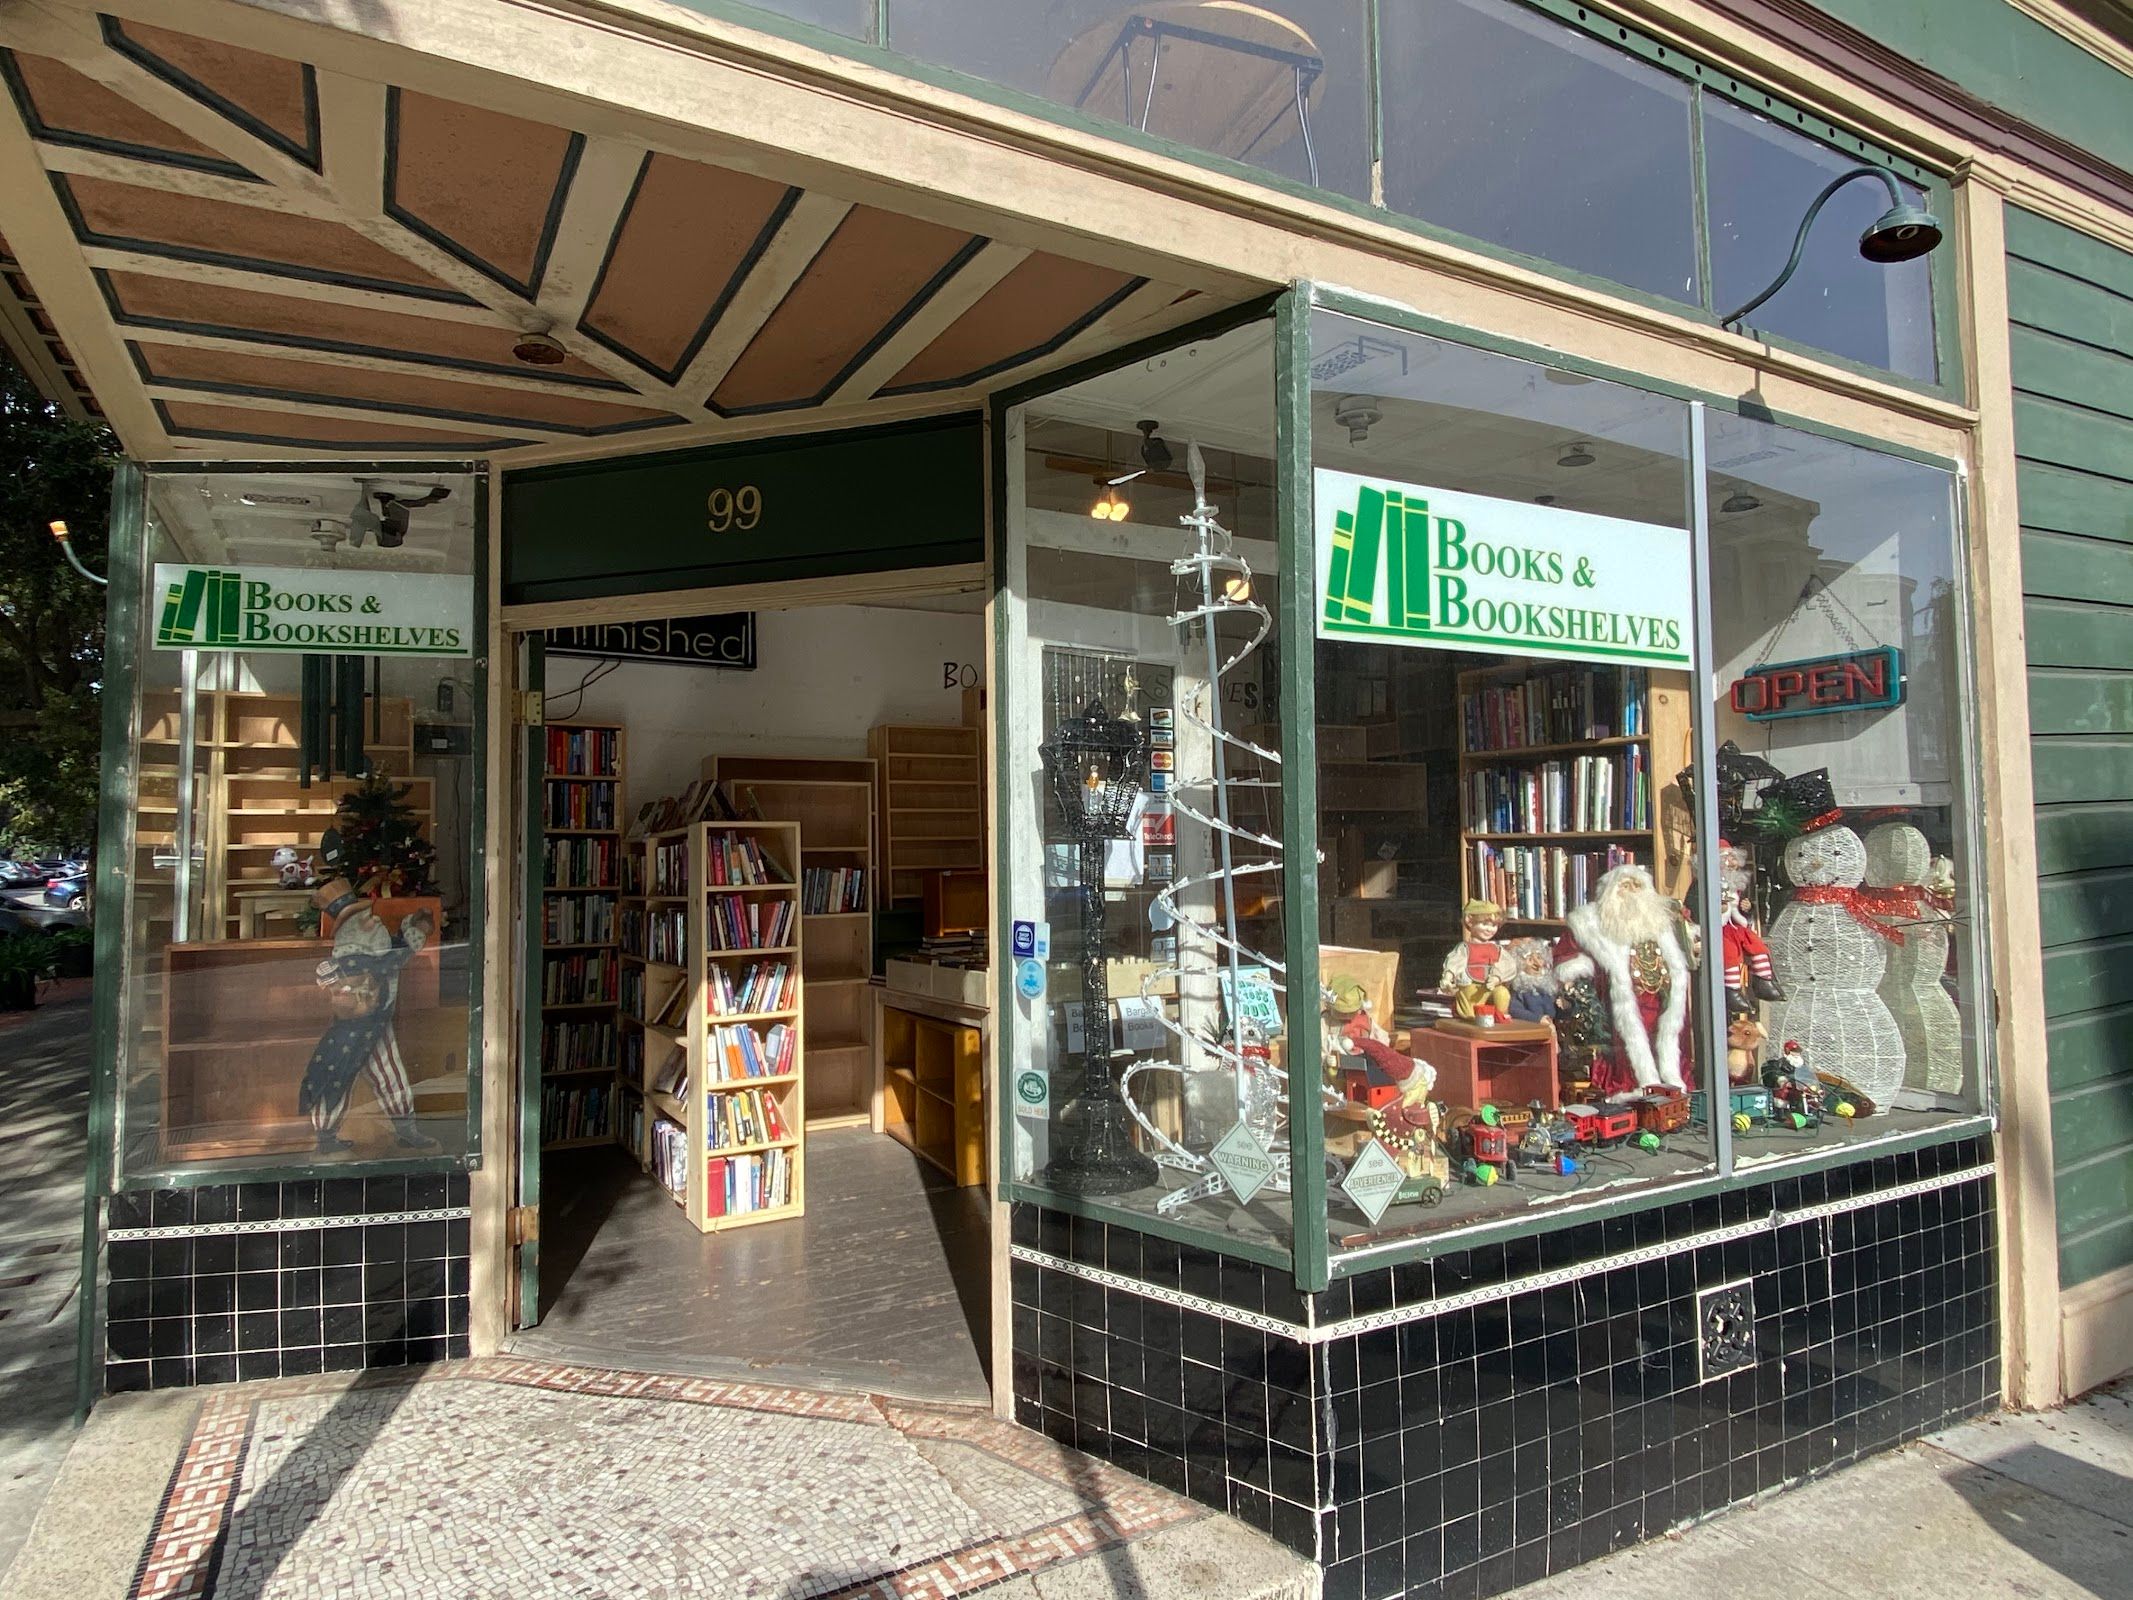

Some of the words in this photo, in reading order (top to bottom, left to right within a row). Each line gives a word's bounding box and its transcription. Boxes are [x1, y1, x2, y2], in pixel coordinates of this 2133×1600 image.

[708, 485, 762, 532] 99
[1572, 555, 1596, 589] &
[360, 594, 383, 614] &
[1731, 658, 1884, 714] OPEN
[1155, 735, 1169, 743] VISA
[1218, 1151, 1270, 1173] WARNING
